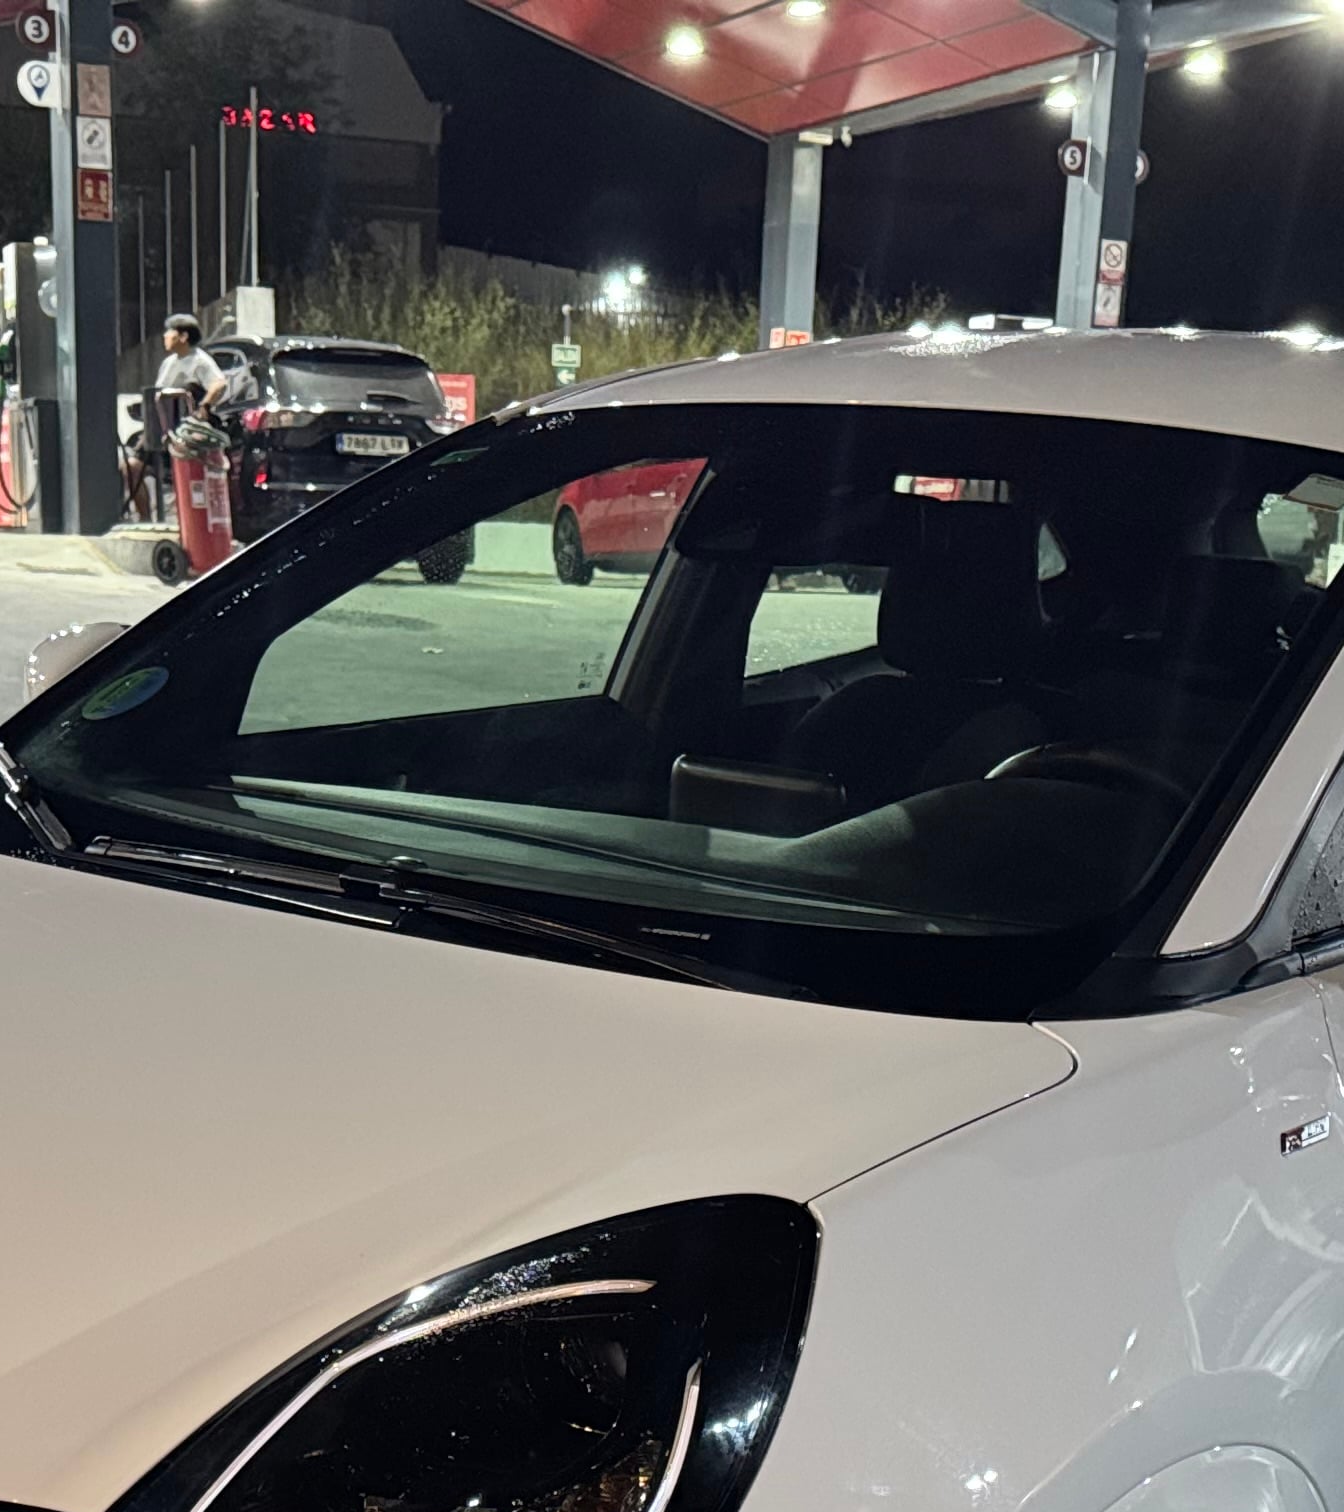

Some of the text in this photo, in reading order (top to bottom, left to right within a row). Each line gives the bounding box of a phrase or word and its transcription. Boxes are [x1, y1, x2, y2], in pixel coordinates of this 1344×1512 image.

[31, 20, 43, 38] 3
[118, 30, 130, 48] 4
[1069, 150, 1077, 165] 5
